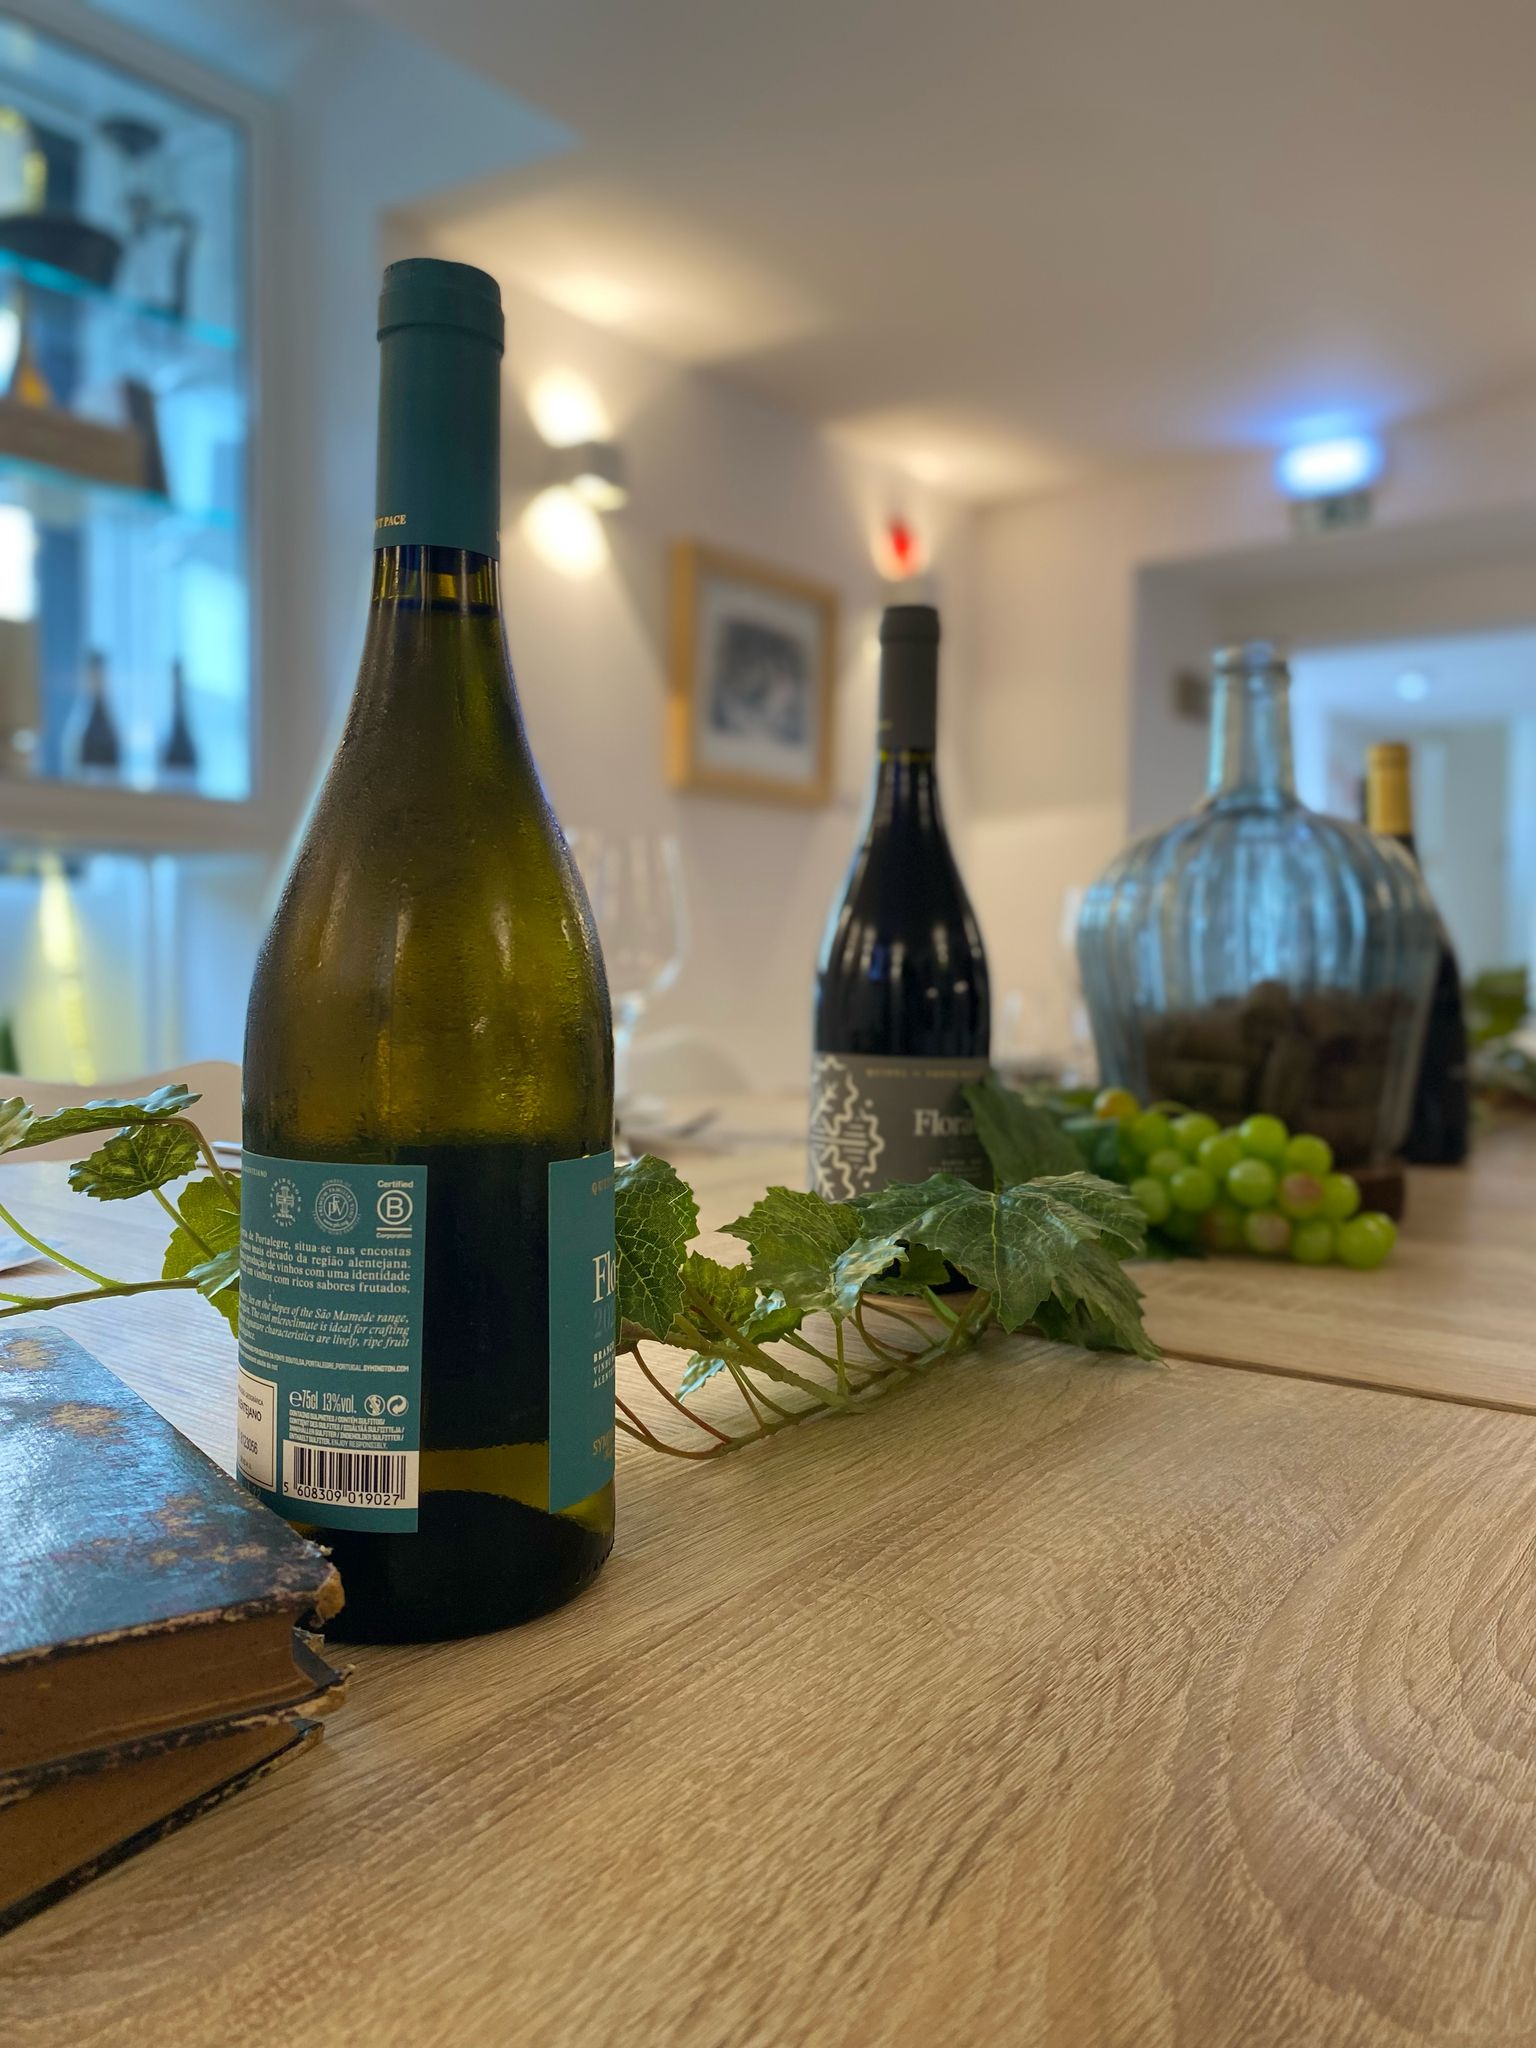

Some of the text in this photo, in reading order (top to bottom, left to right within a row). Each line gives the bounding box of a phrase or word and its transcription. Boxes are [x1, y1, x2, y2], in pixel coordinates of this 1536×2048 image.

[384, 514, 407, 527] PACE
[377, 1180, 414, 1189] Certified
[386, 1197, 404, 1218] B
[255, 1232, 291, 1250] Portalegre,
[294, 1241, 331, 1254] situa-se
[336, 1246, 355, 1256] nas
[360, 1246, 412, 1257] encostas
[376, 1232, 413, 1240] Corporation
[266, 1248, 293, 1262] elevado
[296, 1253, 307, 1264] da
[312, 1255, 344, 1268] região
[348, 1257, 411, 1270] alentejana.
[277, 1263, 304, 1276] vinhos
[305, 1267, 325, 1278] com
[327, 1271, 349, 1280] uma
[352, 1269, 411, 1281] identidade
[592, 1250, 616, 1304] Flo
[274, 1275, 290, 1286] com
[292, 1277, 314, 1289] ricos
[316, 1281, 355, 1292] sabores
[271, 1313, 317, 1332] microclimate
[320, 1321, 327, 1332] is
[329, 1321, 352, 1335] ideal
[352, 1323, 366, 1336] for
[369, 1325, 410, 1337] crafting
[291, 1306, 300, 1318] of
[301, 1306, 314, 1319] the
[315, 1308, 332, 1320] São
[334, 1310, 375, 1322] Mamede
[377, 1314, 410, 1325] range,
[264, 1324, 316, 1343] characteristics
[316, 1335, 331, 1345] are
[363, 1337, 383, 1348] ripe
[384, 1338, 409, 1350] fruit
[283, 1482, 400, 1506] 5 608309 019027
